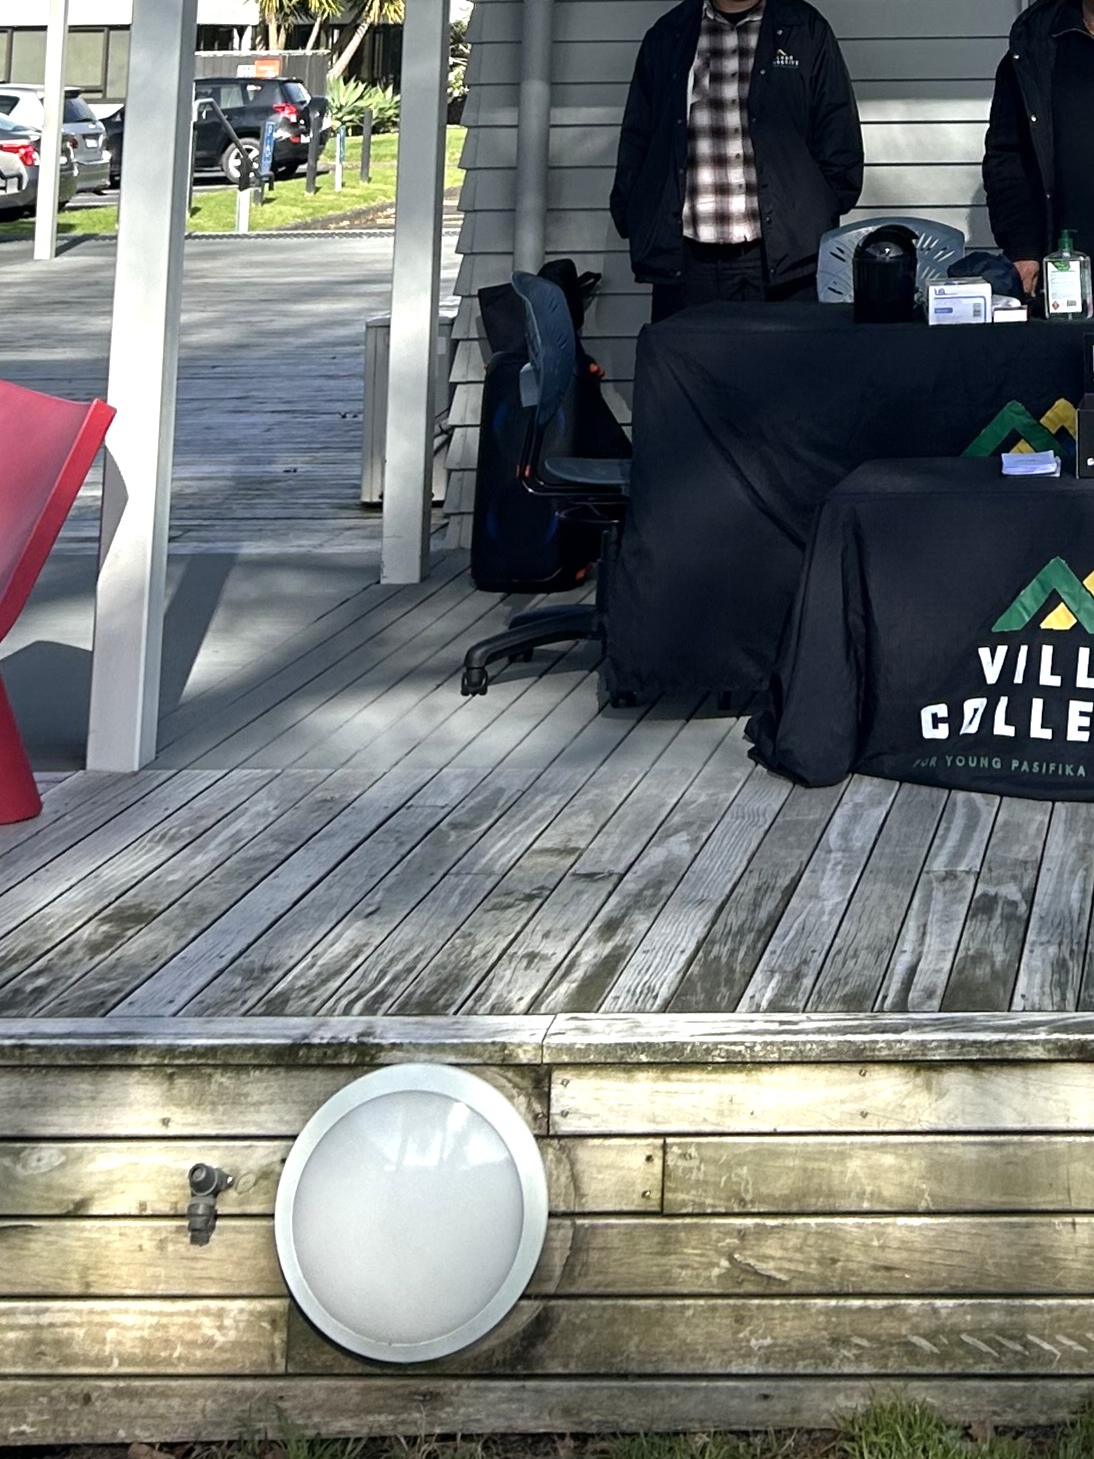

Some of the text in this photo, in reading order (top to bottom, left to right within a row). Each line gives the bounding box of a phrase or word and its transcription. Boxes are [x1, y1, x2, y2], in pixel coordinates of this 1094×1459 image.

[912, 756, 938, 768] FOR
[945, 755, 1002, 769] YOUNG
[1011, 759, 1087, 777] PASIFIKA
